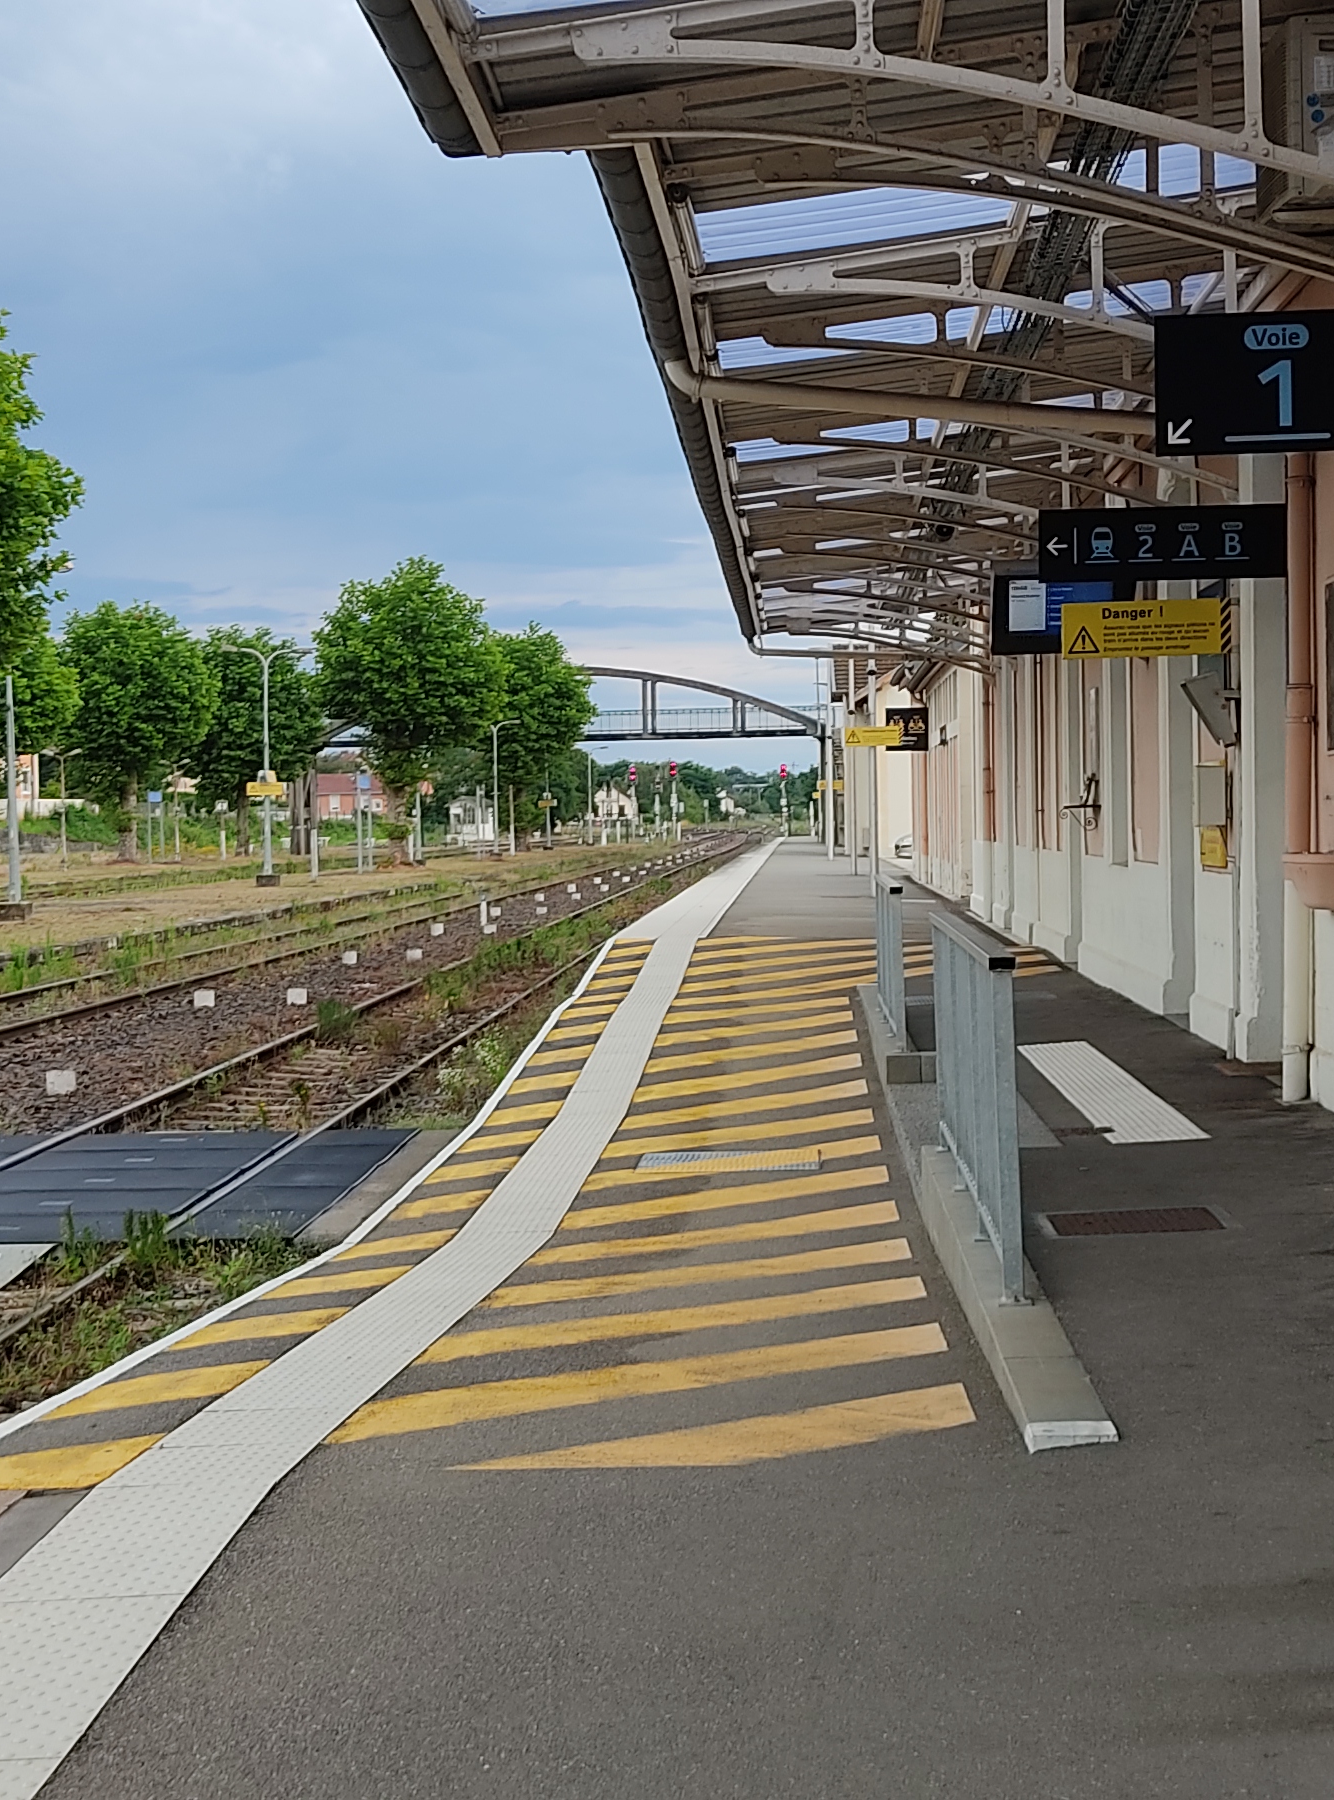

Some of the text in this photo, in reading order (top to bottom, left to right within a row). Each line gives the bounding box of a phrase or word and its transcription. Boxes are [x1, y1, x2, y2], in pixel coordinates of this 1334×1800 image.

[1251, 327, 1301, 347] Voie
[1257, 359, 1293, 427] 1
[1138, 533, 1242, 558] 2 A B
[1102, 605, 1163, 620] Danger !
